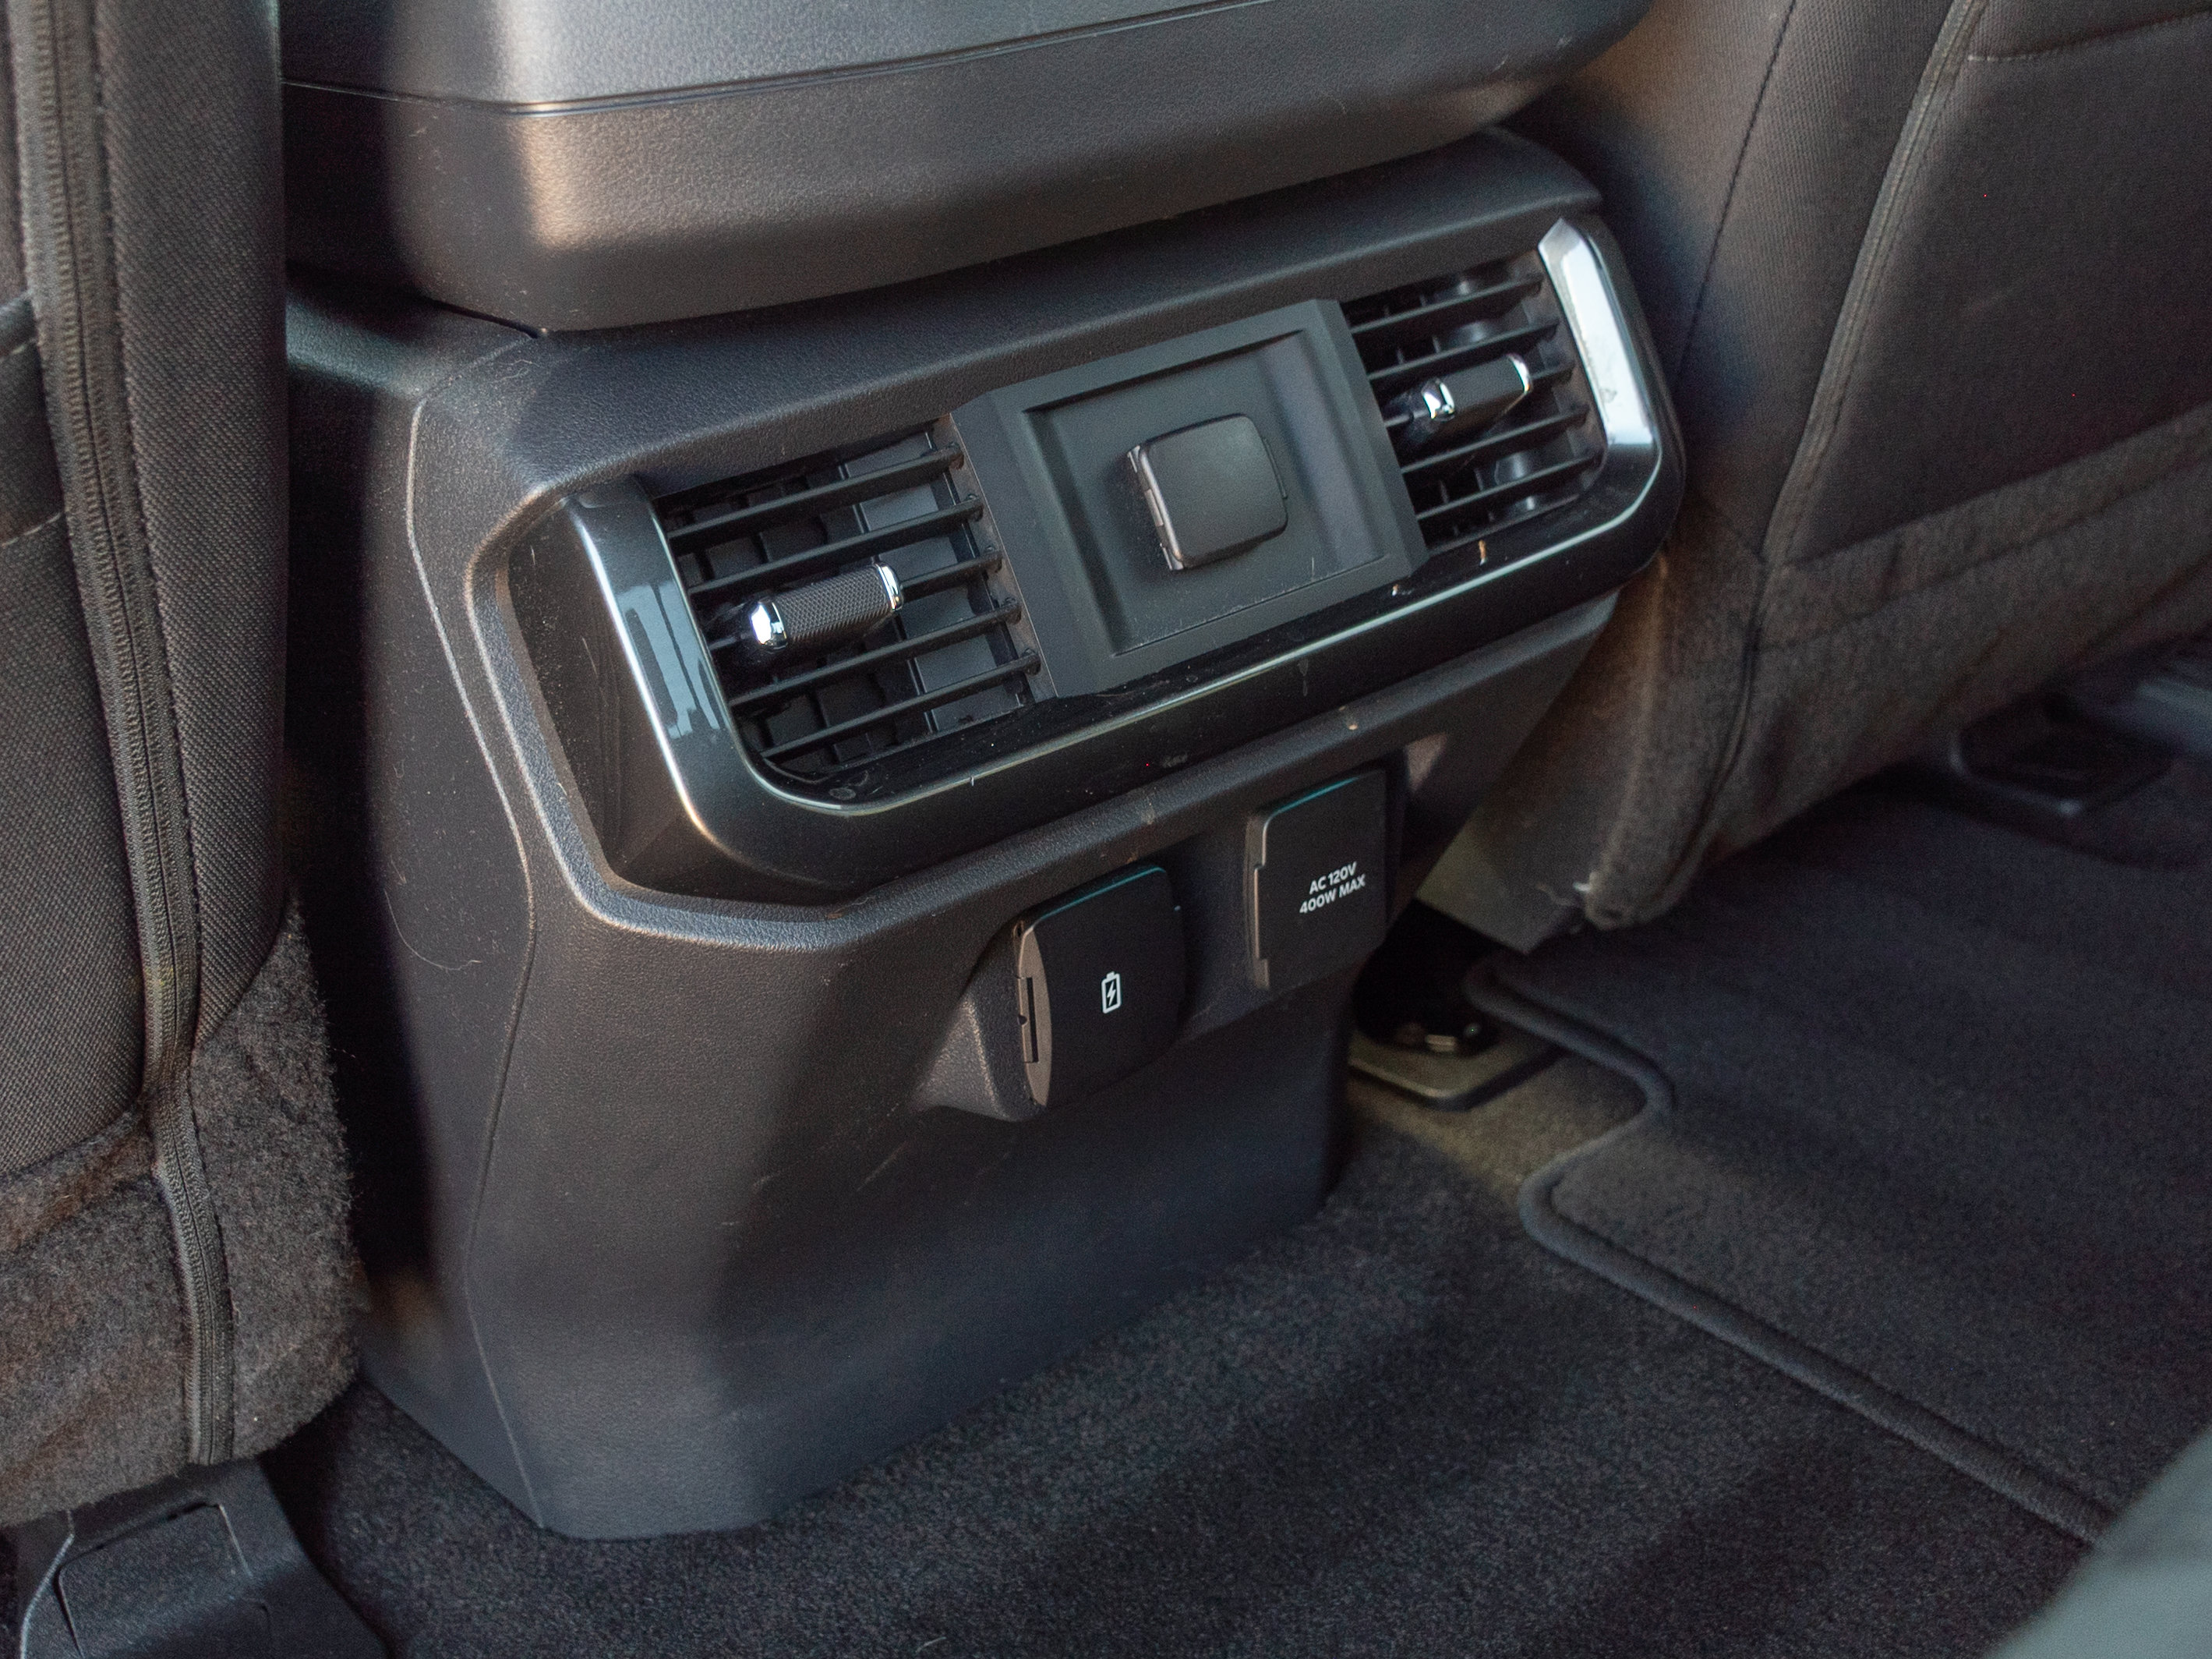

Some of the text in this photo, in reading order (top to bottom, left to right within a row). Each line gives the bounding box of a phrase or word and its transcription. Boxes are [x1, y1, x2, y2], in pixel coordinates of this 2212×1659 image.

[1299, 873, 1366, 913] 400W MAX
[1309, 861, 1357, 894] AC 120V
